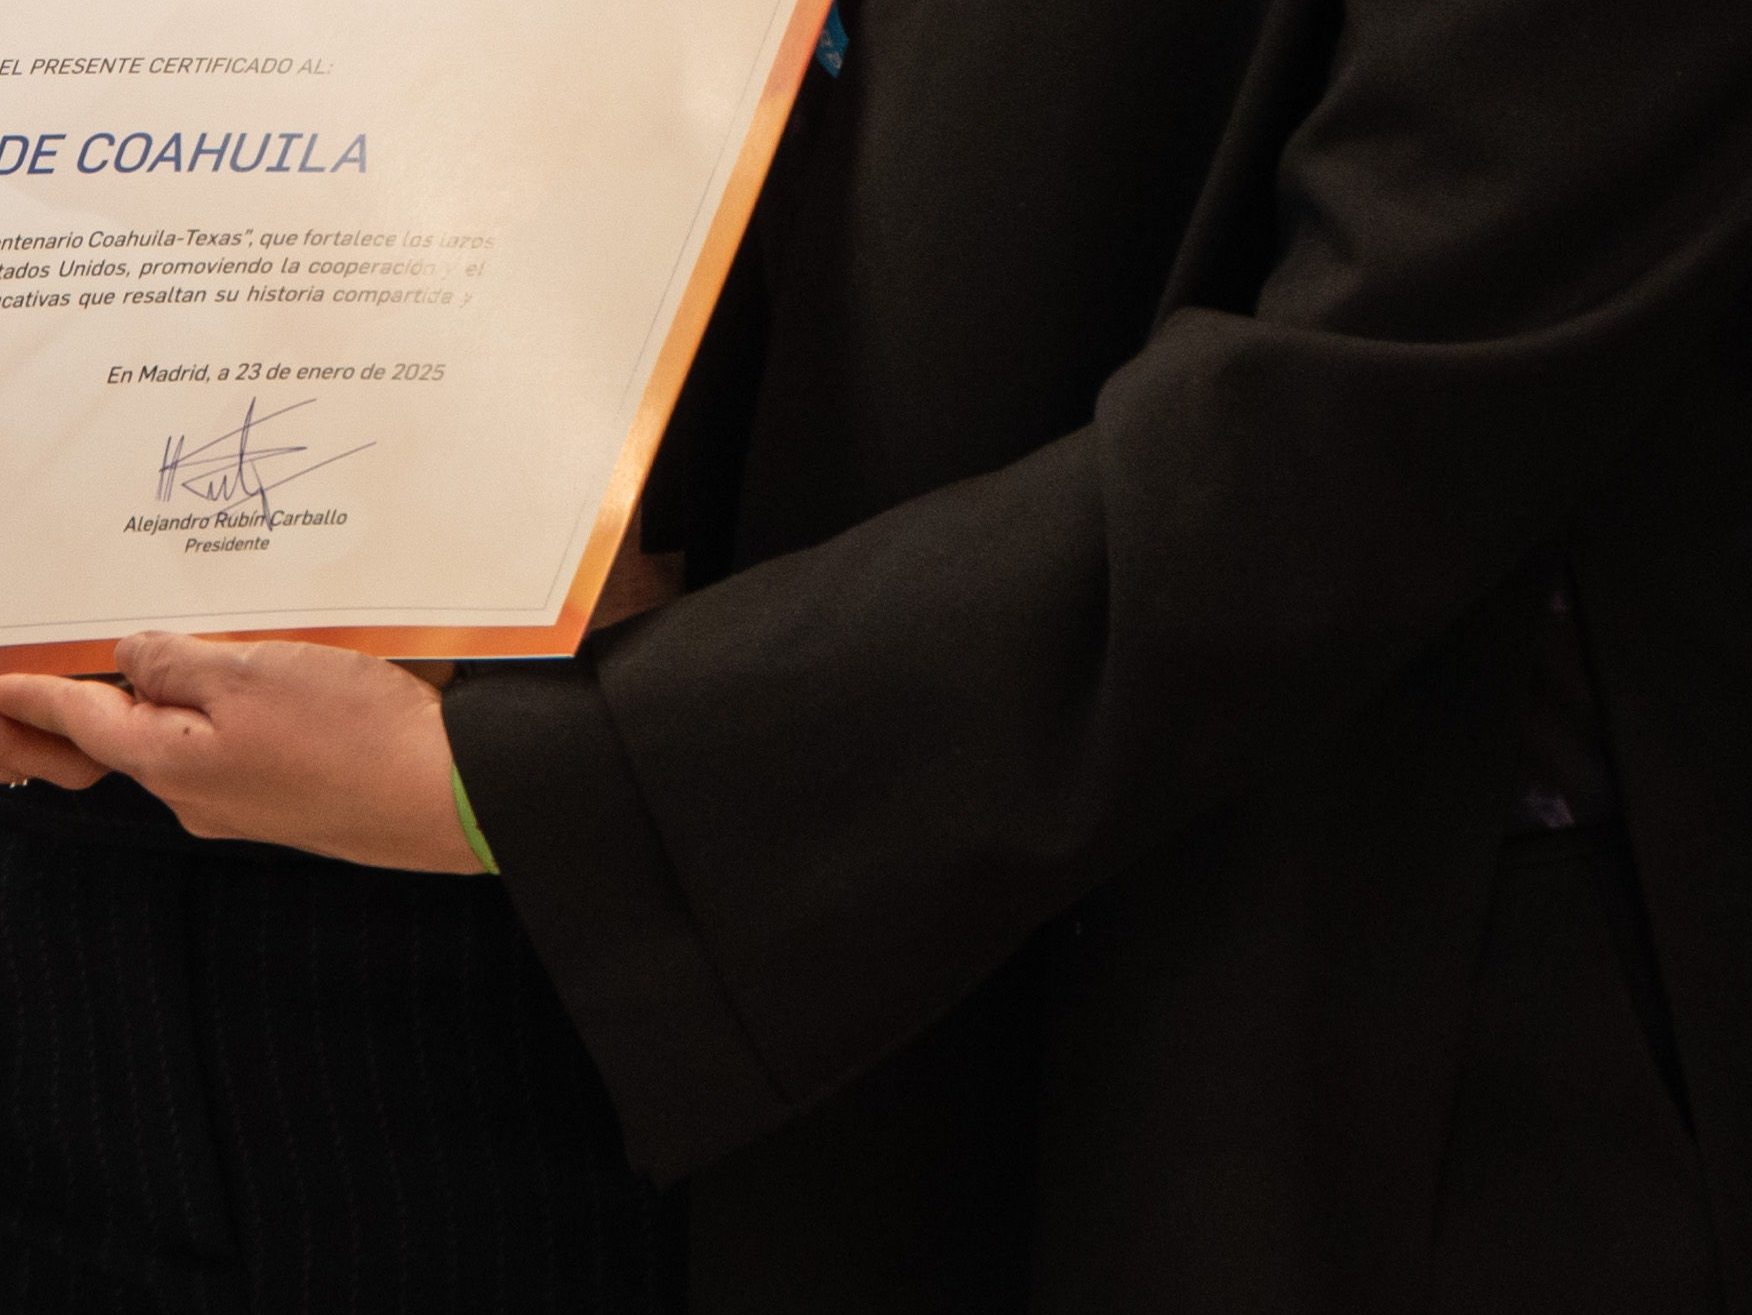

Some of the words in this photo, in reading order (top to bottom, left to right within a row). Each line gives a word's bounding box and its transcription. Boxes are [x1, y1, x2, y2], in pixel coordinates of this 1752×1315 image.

[29, 57, 145, 76] PRESENTE
[148, 57, 294, 75] CERTIFICADO
[299, 57, 334, 75] AL:
[76, 132, 369, 174] COAHUILA
[259, 231, 298, 249] que
[303, 230, 397, 249] fortalece
[402, 231, 433, 249] los
[58, 259, 131, 279] Unidos,
[138, 256, 274, 280] promoviendo
[281, 258, 301, 275] la
[307, 257, 438, 279] cooperación
[465, 262, 485, 278] el
[77, 288, 116, 309] que
[122, 286, 207, 306] resaltan
[214, 285, 240, 304] su
[246, 284, 325, 304] historia
[332, 285, 452, 307] compartida
[107, 366, 133, 385] En
[137, 364, 211, 383] Madrid,
[218, 367, 230, 382] a
[235, 363, 262, 382] 23
[266, 363, 292, 381] de
[295, 365, 355, 381] enero
[360, 363, 386, 381] de
[390, 363, 446, 382] 2025
[123, 512, 210, 534] Alejandro
[214, 510, 266, 529] Rubín
[270, 509, 348, 527] Carballo
[184, 537, 270, 554] Presidente
